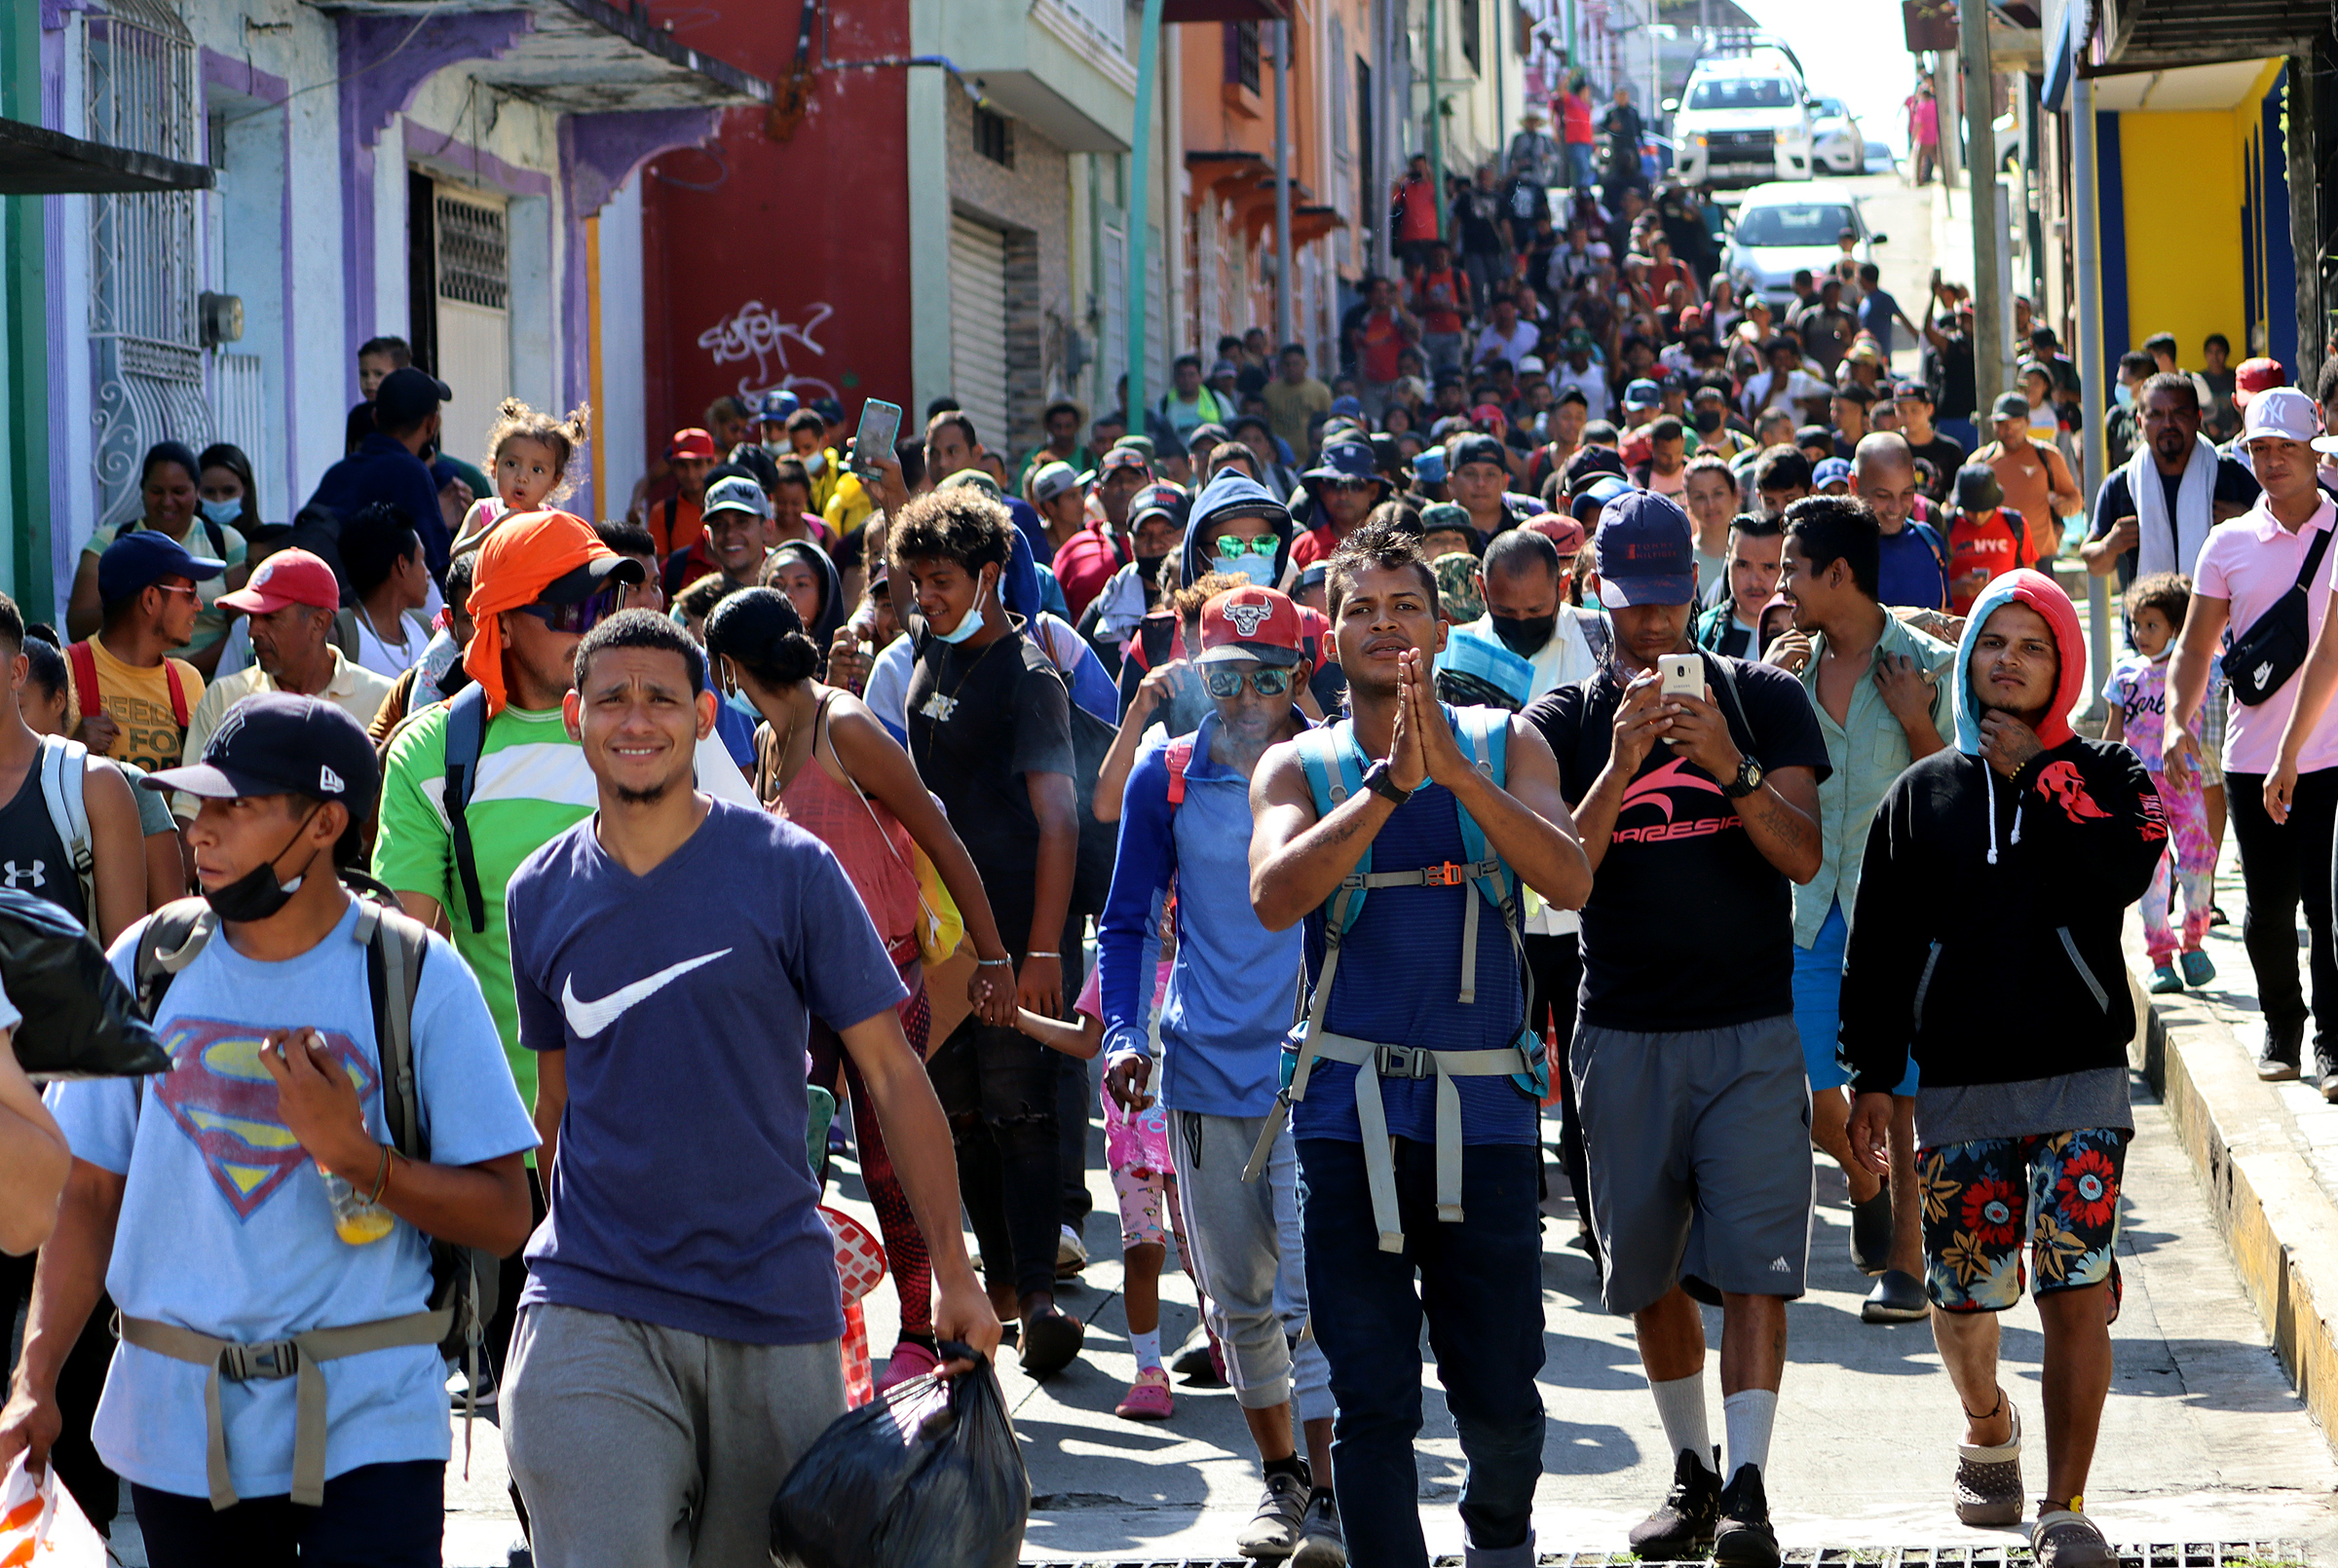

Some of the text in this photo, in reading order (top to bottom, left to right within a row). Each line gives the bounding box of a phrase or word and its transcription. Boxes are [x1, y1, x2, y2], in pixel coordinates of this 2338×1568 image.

[2259, 394, 2286, 424] NY
[1974, 538, 2009, 554] NYC
[129, 727, 183, 754] FO
